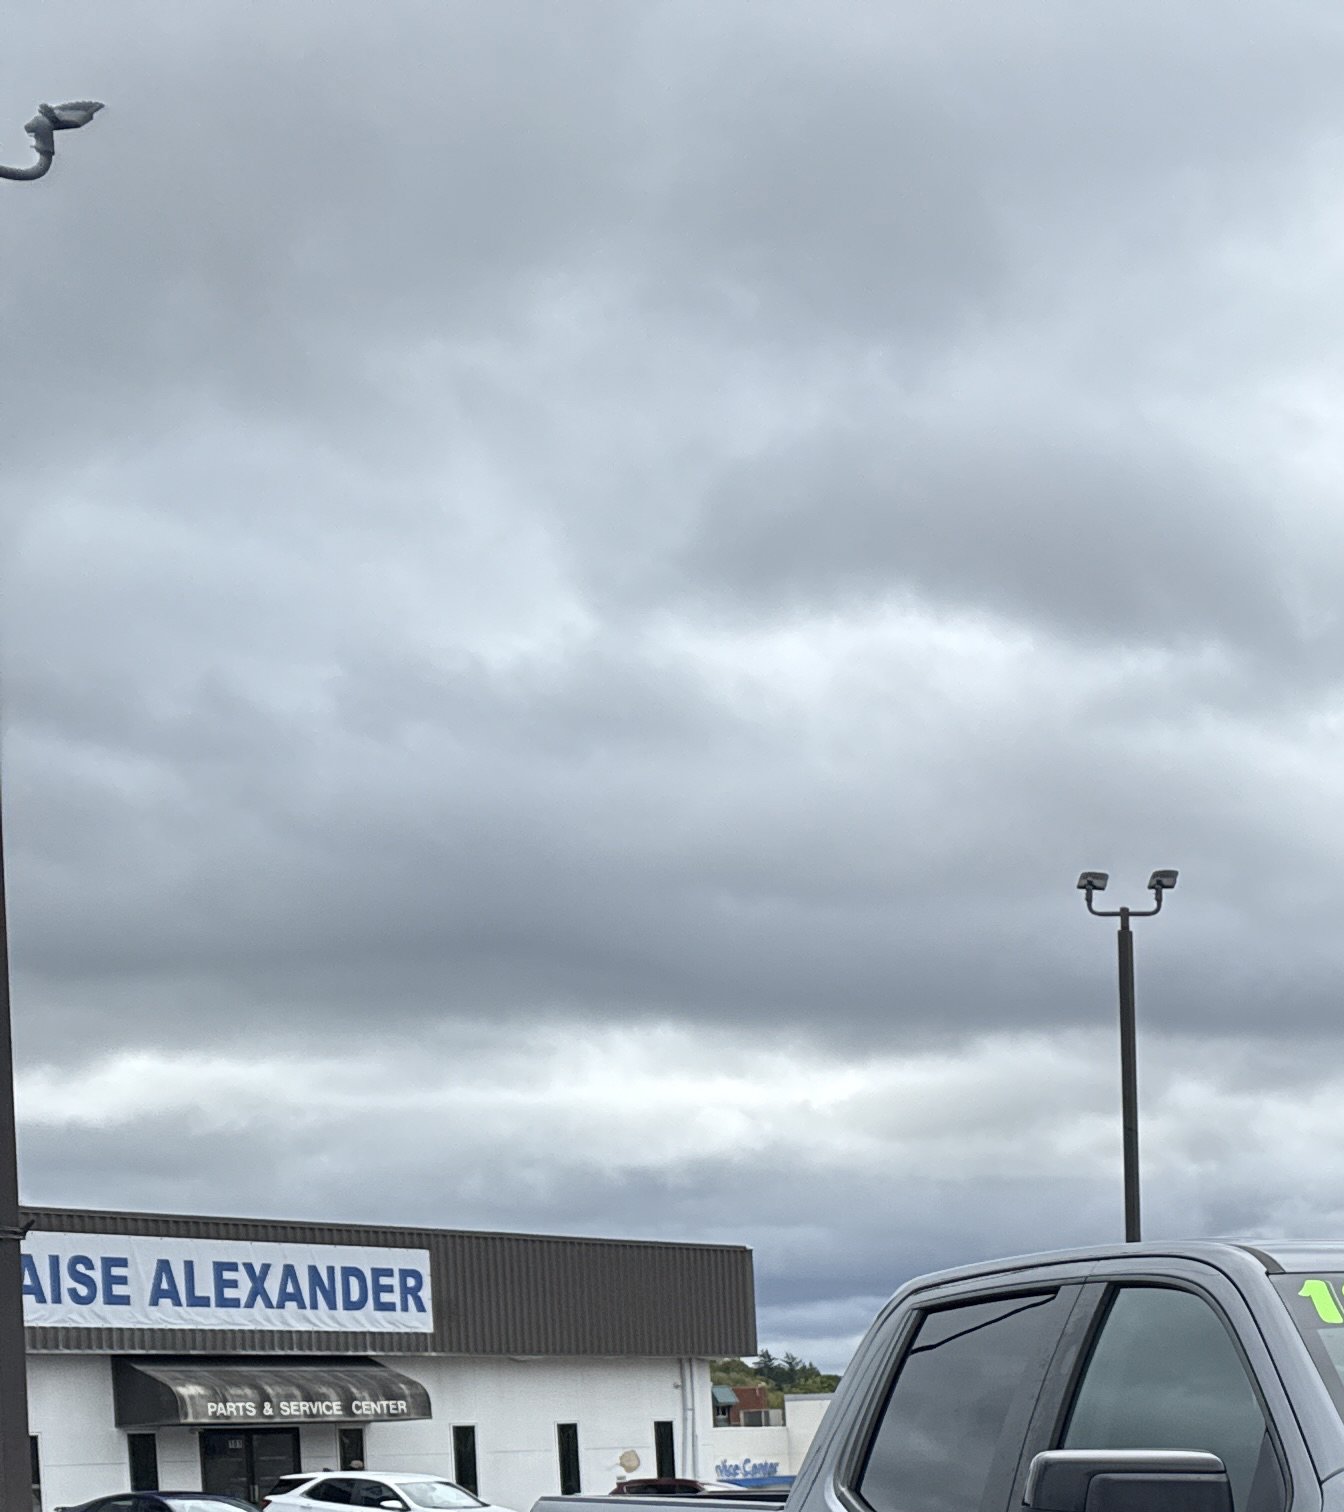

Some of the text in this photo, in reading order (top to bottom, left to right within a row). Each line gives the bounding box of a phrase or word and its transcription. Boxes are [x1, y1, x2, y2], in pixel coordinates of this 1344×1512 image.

[21, 1253, 428, 1313] AISE ALEXANDER
[207, 1400, 408, 1417] PARTS & SERVICE CENTER
